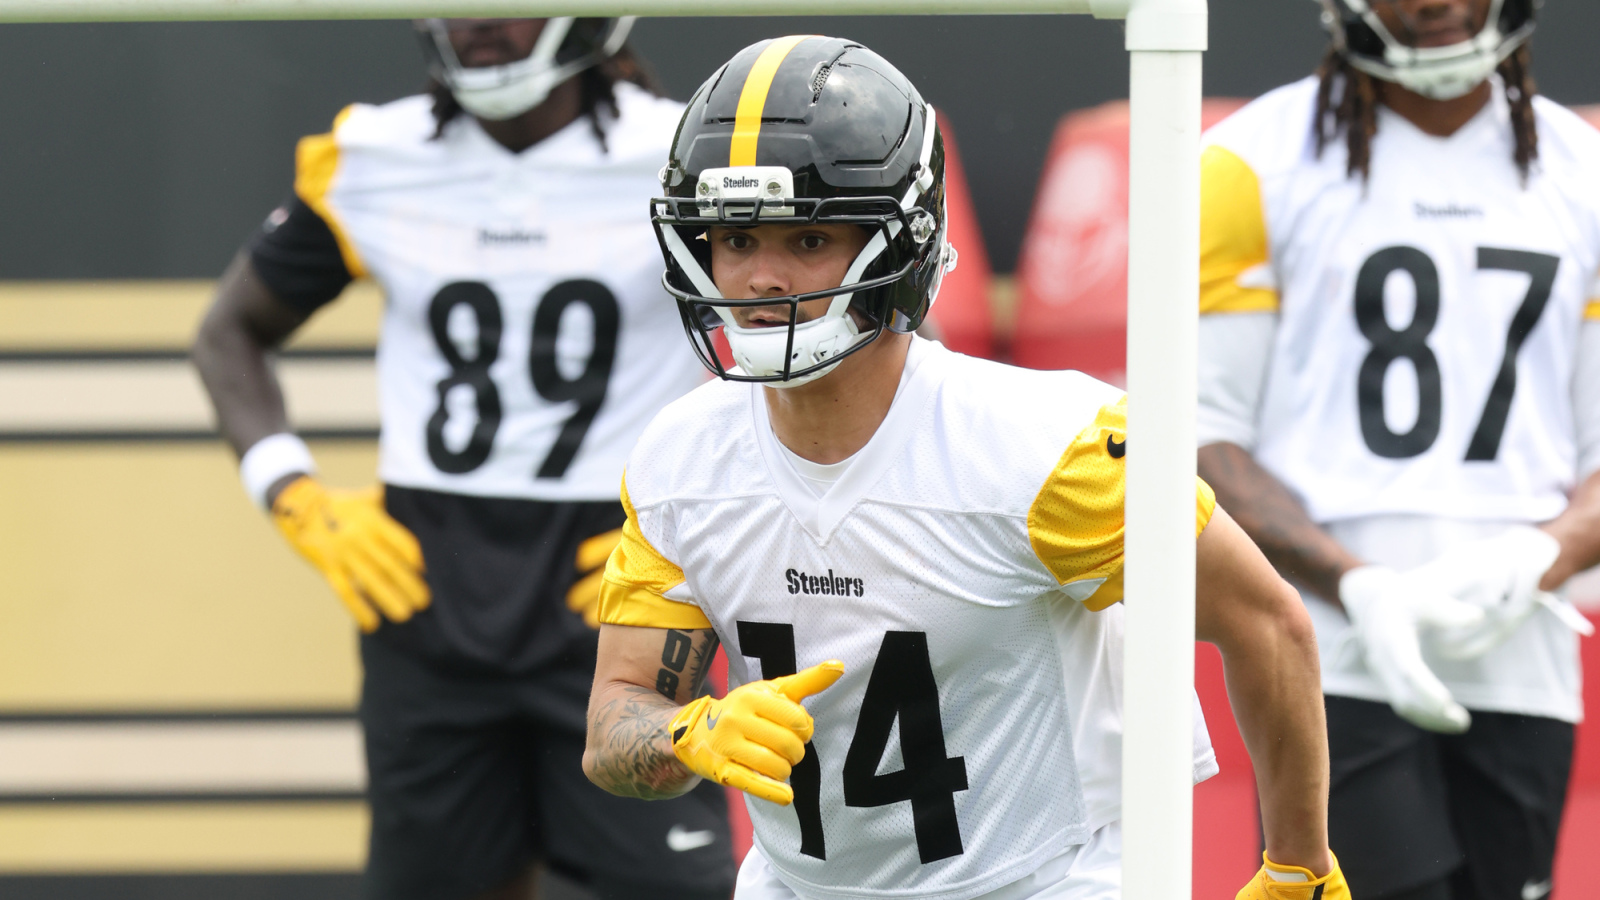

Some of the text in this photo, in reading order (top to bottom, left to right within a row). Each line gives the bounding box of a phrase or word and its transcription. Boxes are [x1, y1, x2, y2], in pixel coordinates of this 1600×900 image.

[723, 176, 759, 188] Steelers
[427, 279, 620, 479] 89
[1354, 245, 1560, 461] 87
[785, 568, 864, 597] Steelers
[736, 620, 969, 865] 14
